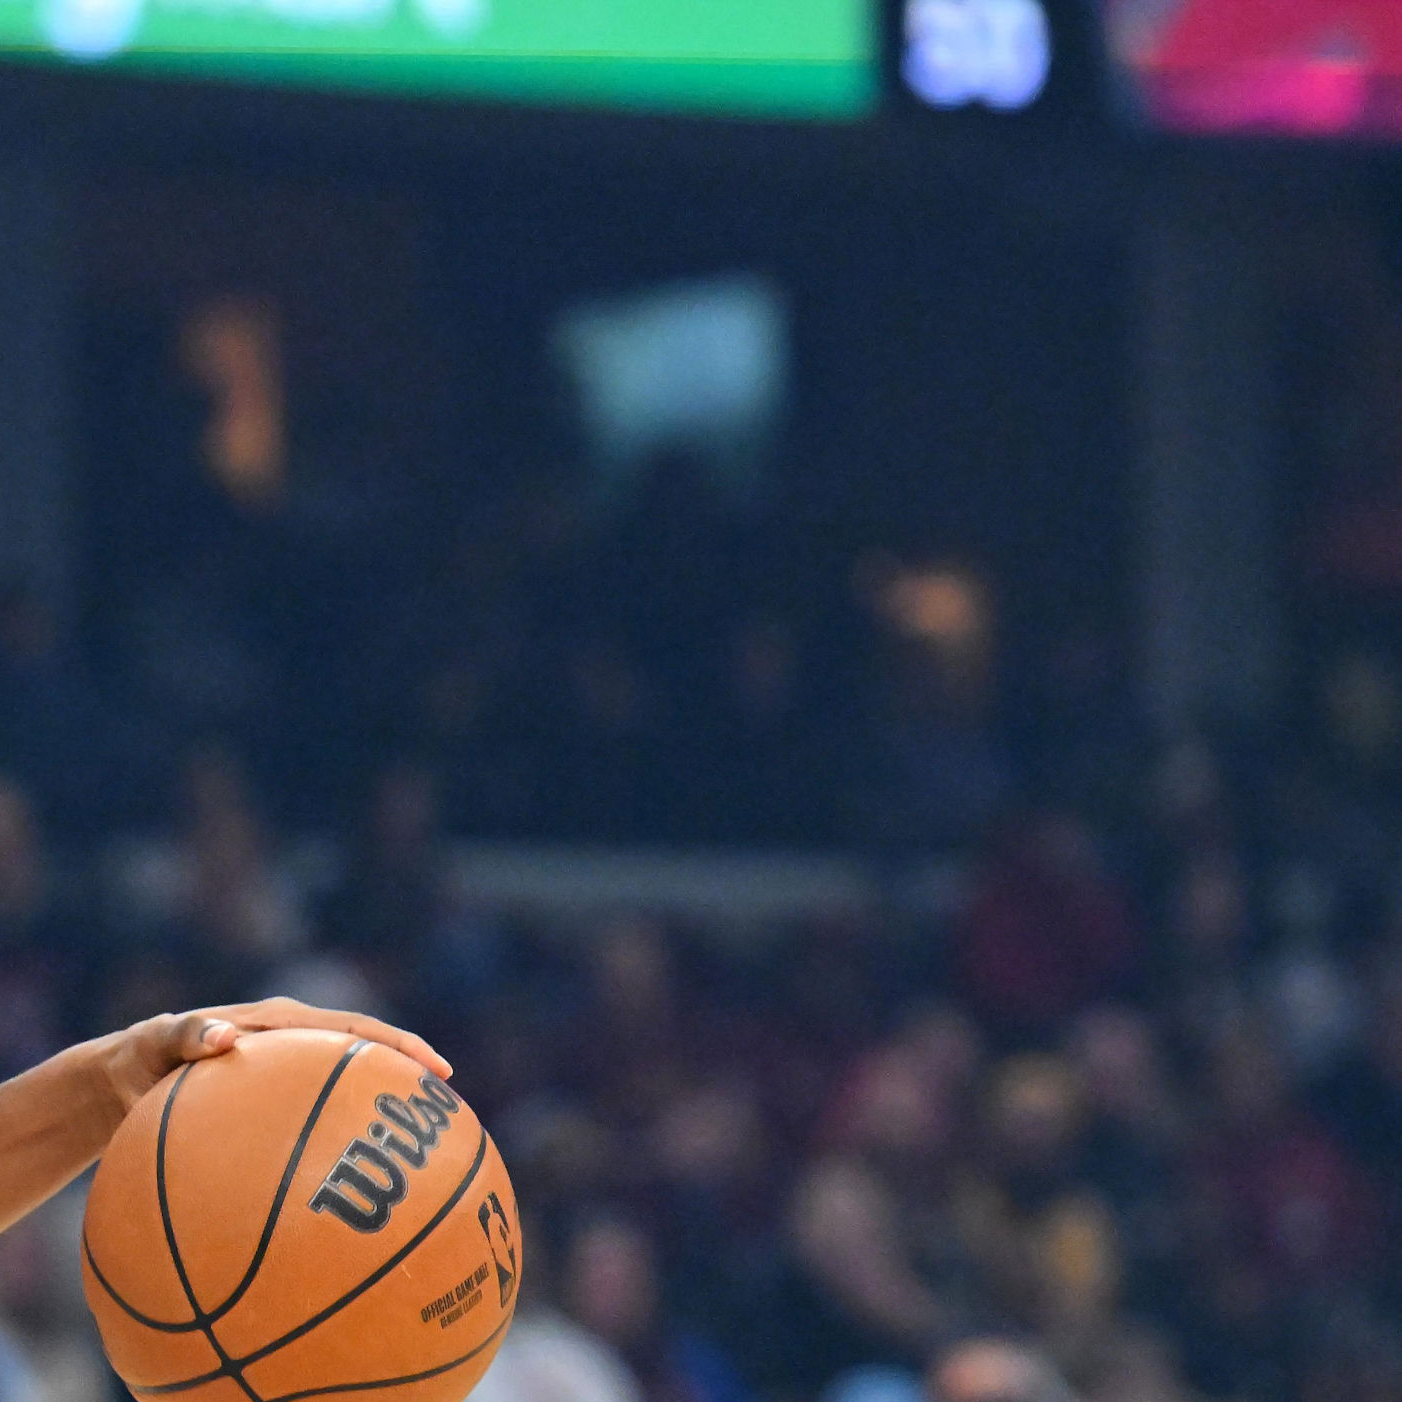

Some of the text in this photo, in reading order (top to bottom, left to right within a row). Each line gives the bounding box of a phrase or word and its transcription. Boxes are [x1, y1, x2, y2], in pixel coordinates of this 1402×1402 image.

[308, 1070, 463, 1234] Wilso
[421, 1290, 456, 1323] OFFICIAL
[455, 1275, 475, 1301] GAME
